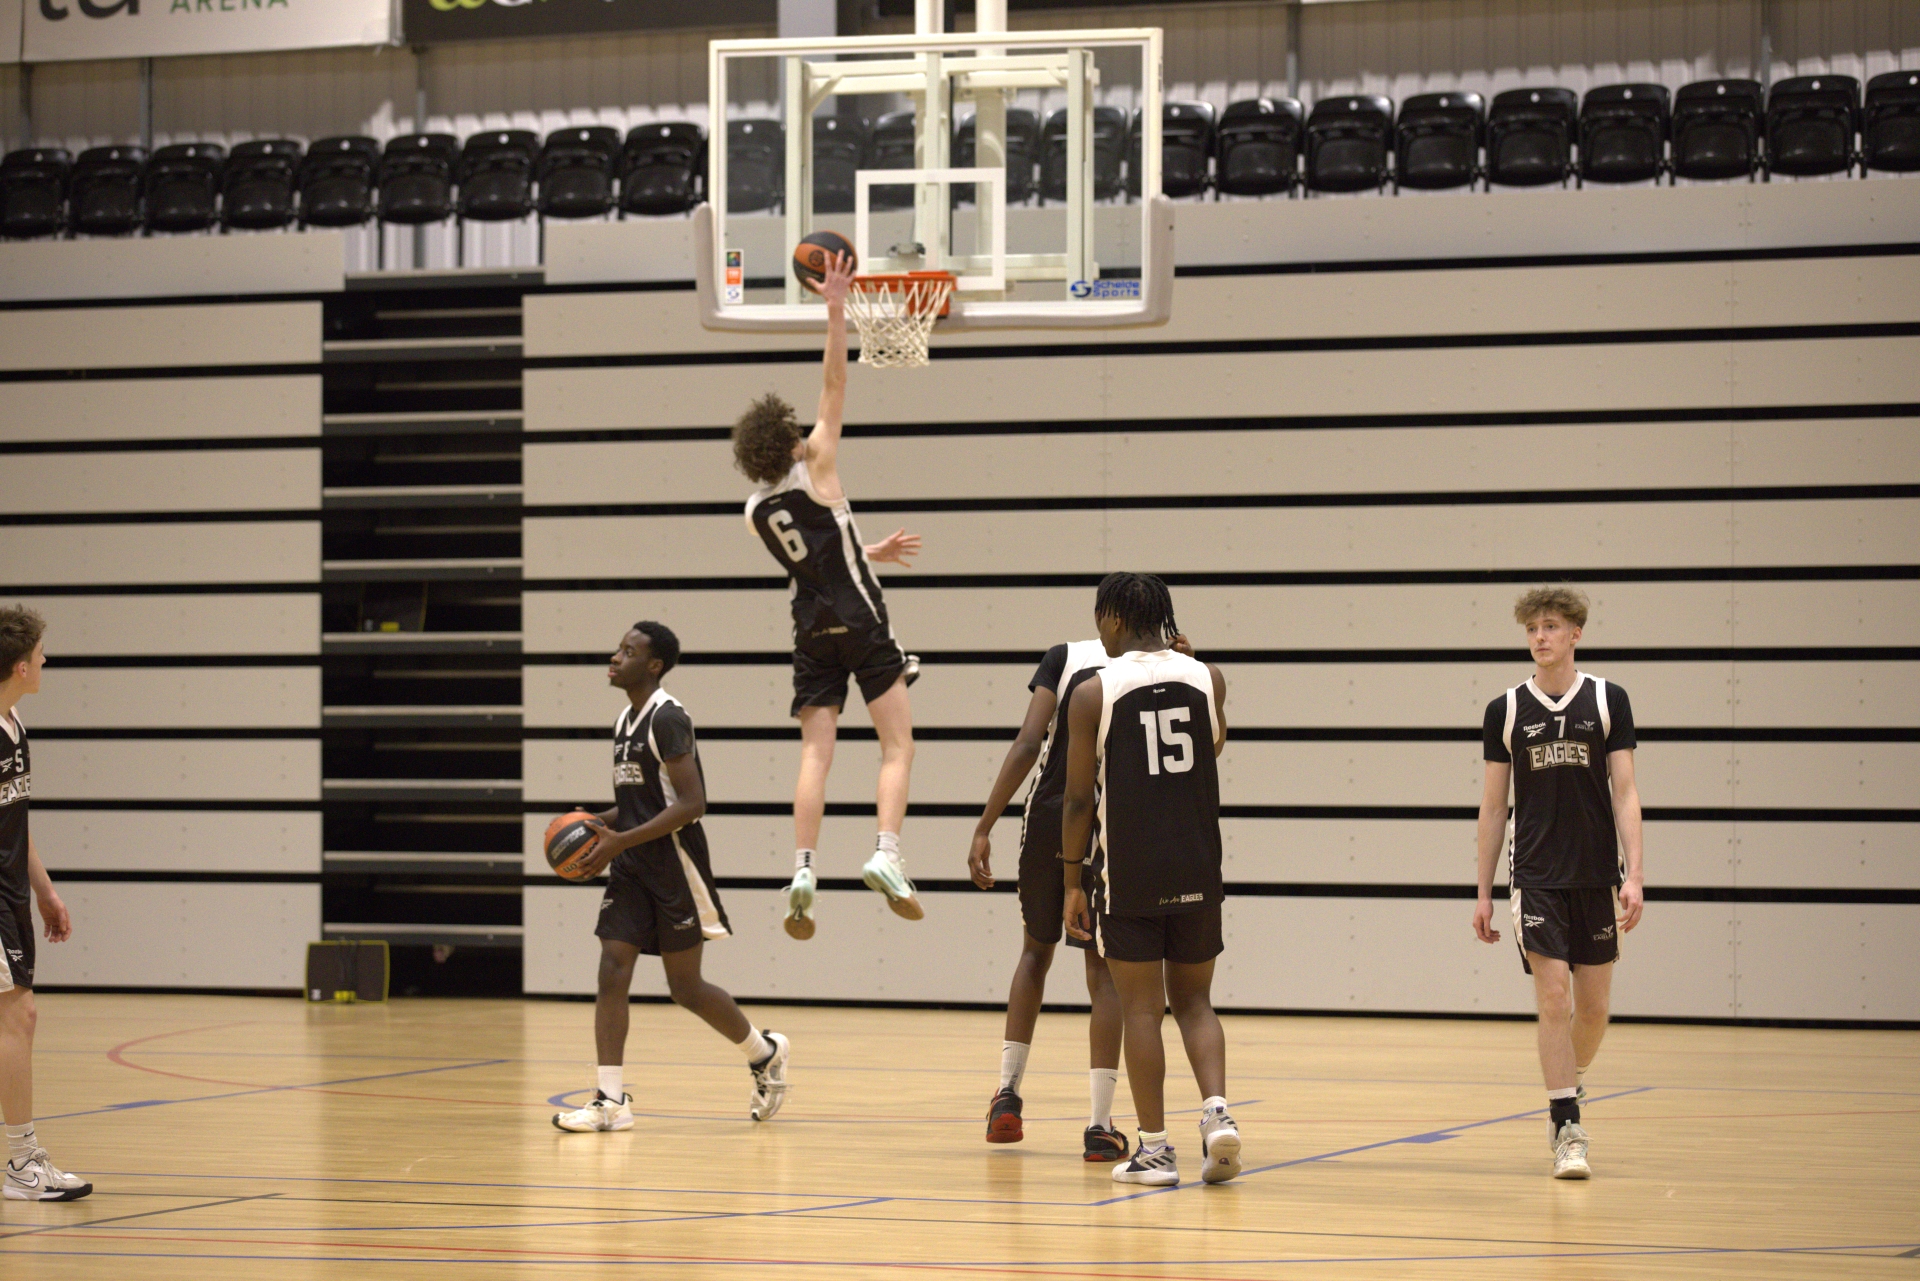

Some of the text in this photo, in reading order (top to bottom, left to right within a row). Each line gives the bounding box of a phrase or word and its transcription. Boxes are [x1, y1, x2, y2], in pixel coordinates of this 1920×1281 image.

[1093, 288, 1139, 298] Sports
[767, 509, 808, 563] 6
[1523, 722, 1547, 732] Reebok
[1554, 715, 1566, 738] 7
[1139, 706, 1194, 775] 15
[1530, 741, 1589, 768] EAGLES
[1523, 913, 1545, 922] Reebok
